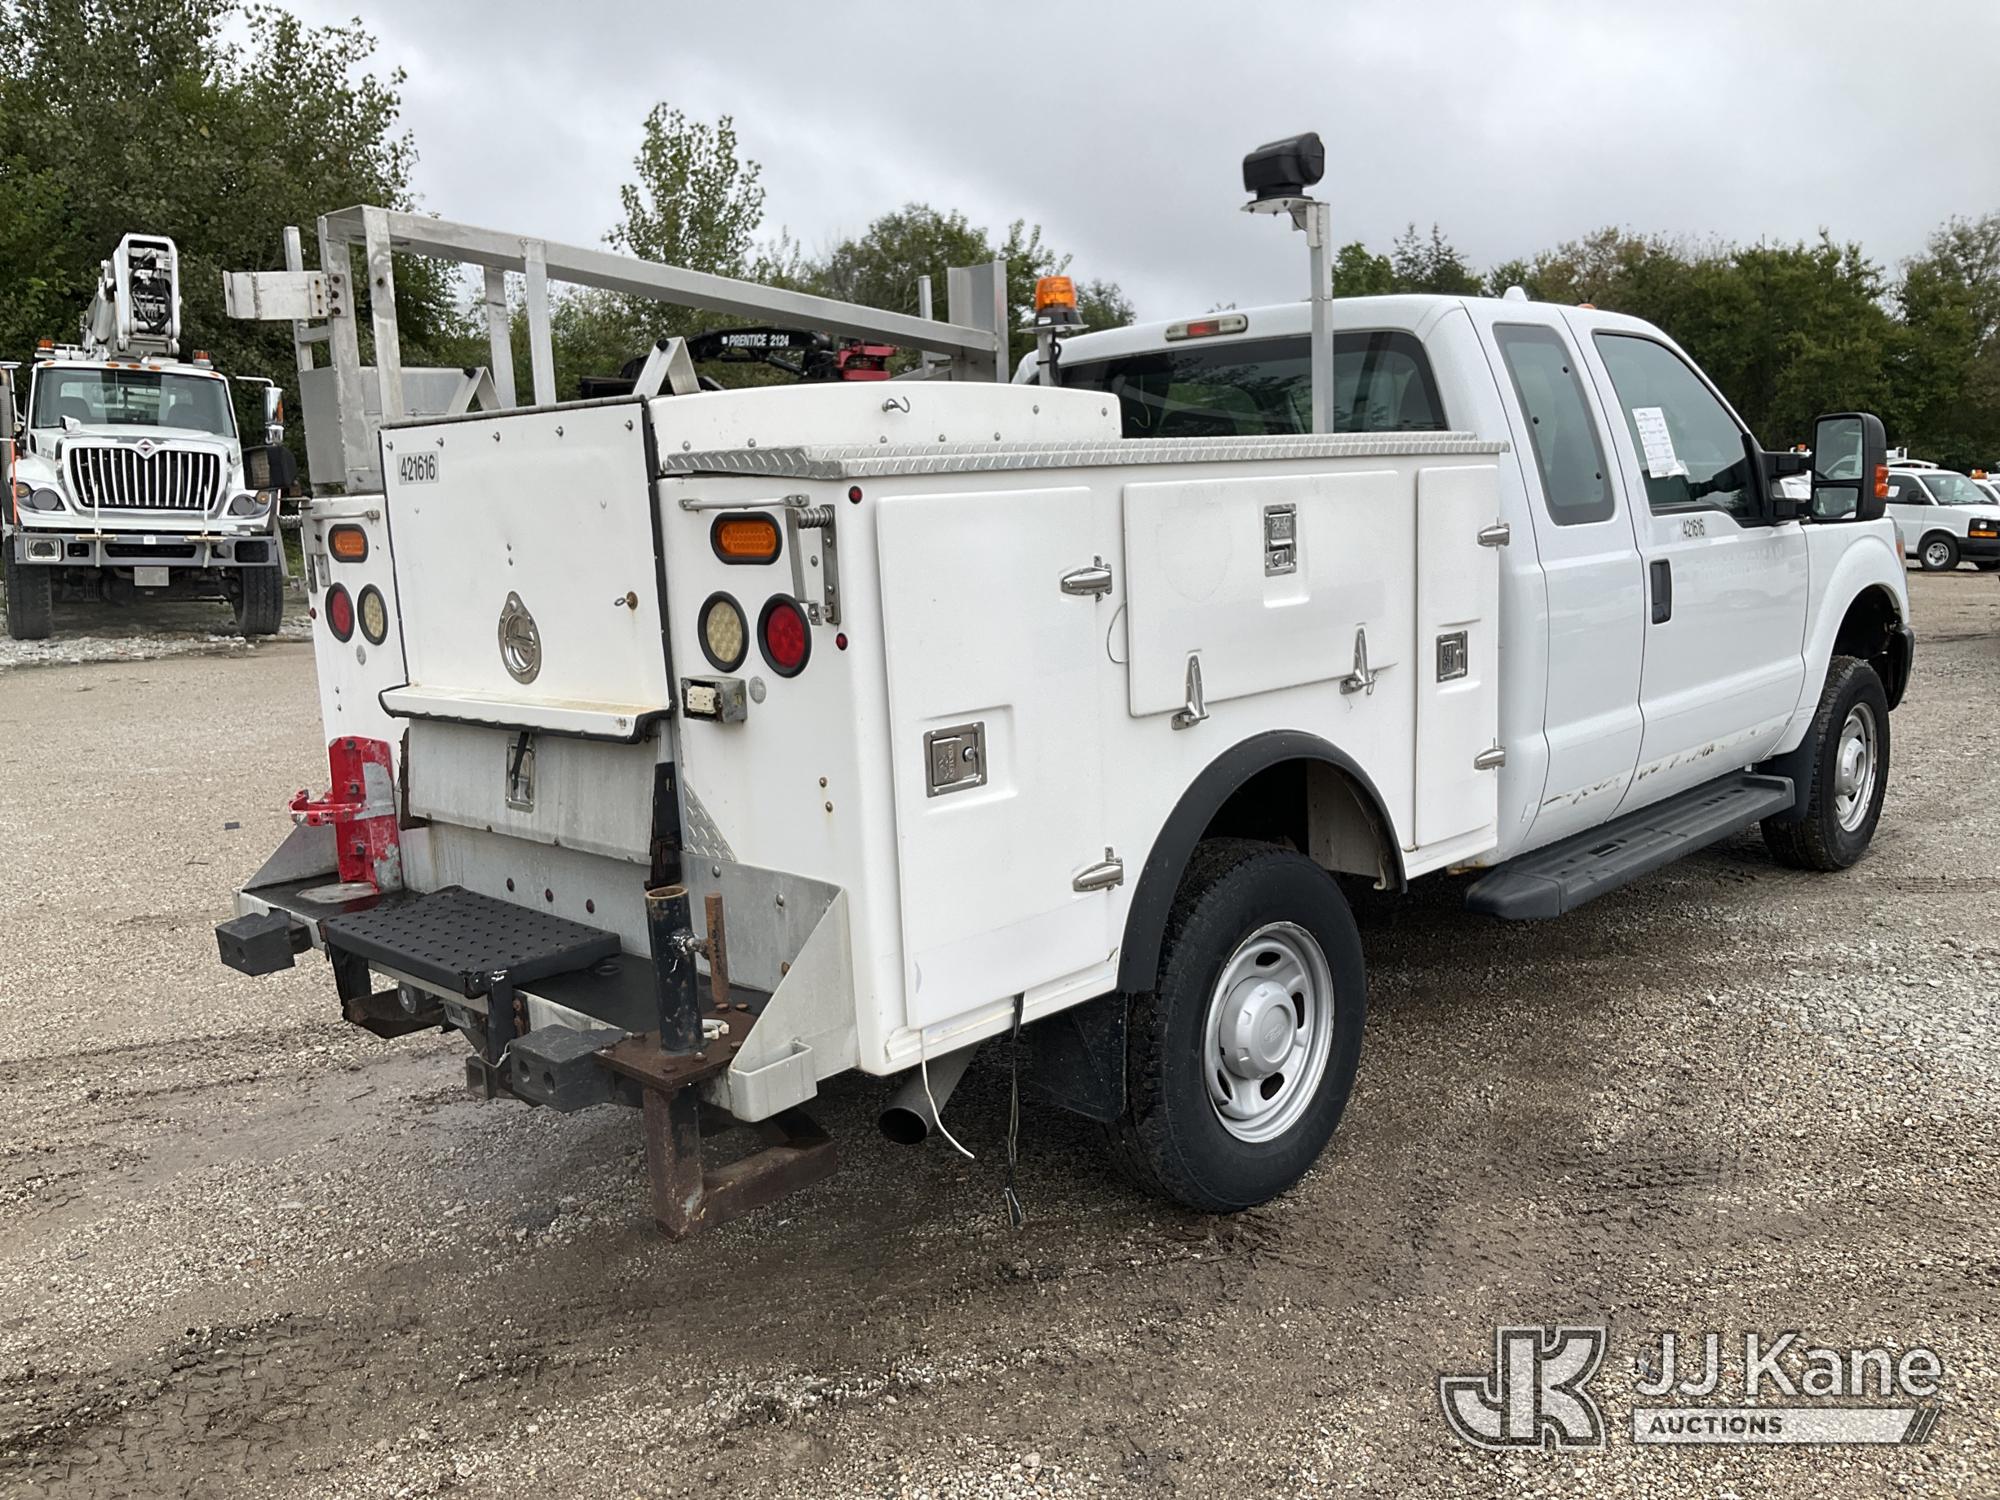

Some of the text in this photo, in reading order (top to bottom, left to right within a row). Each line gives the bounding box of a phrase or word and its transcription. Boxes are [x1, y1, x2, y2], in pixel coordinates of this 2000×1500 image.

[728, 333, 767, 347] PRENTICE
[401, 454, 436, 482] 421616
[1682, 518, 1705, 537] 421616
